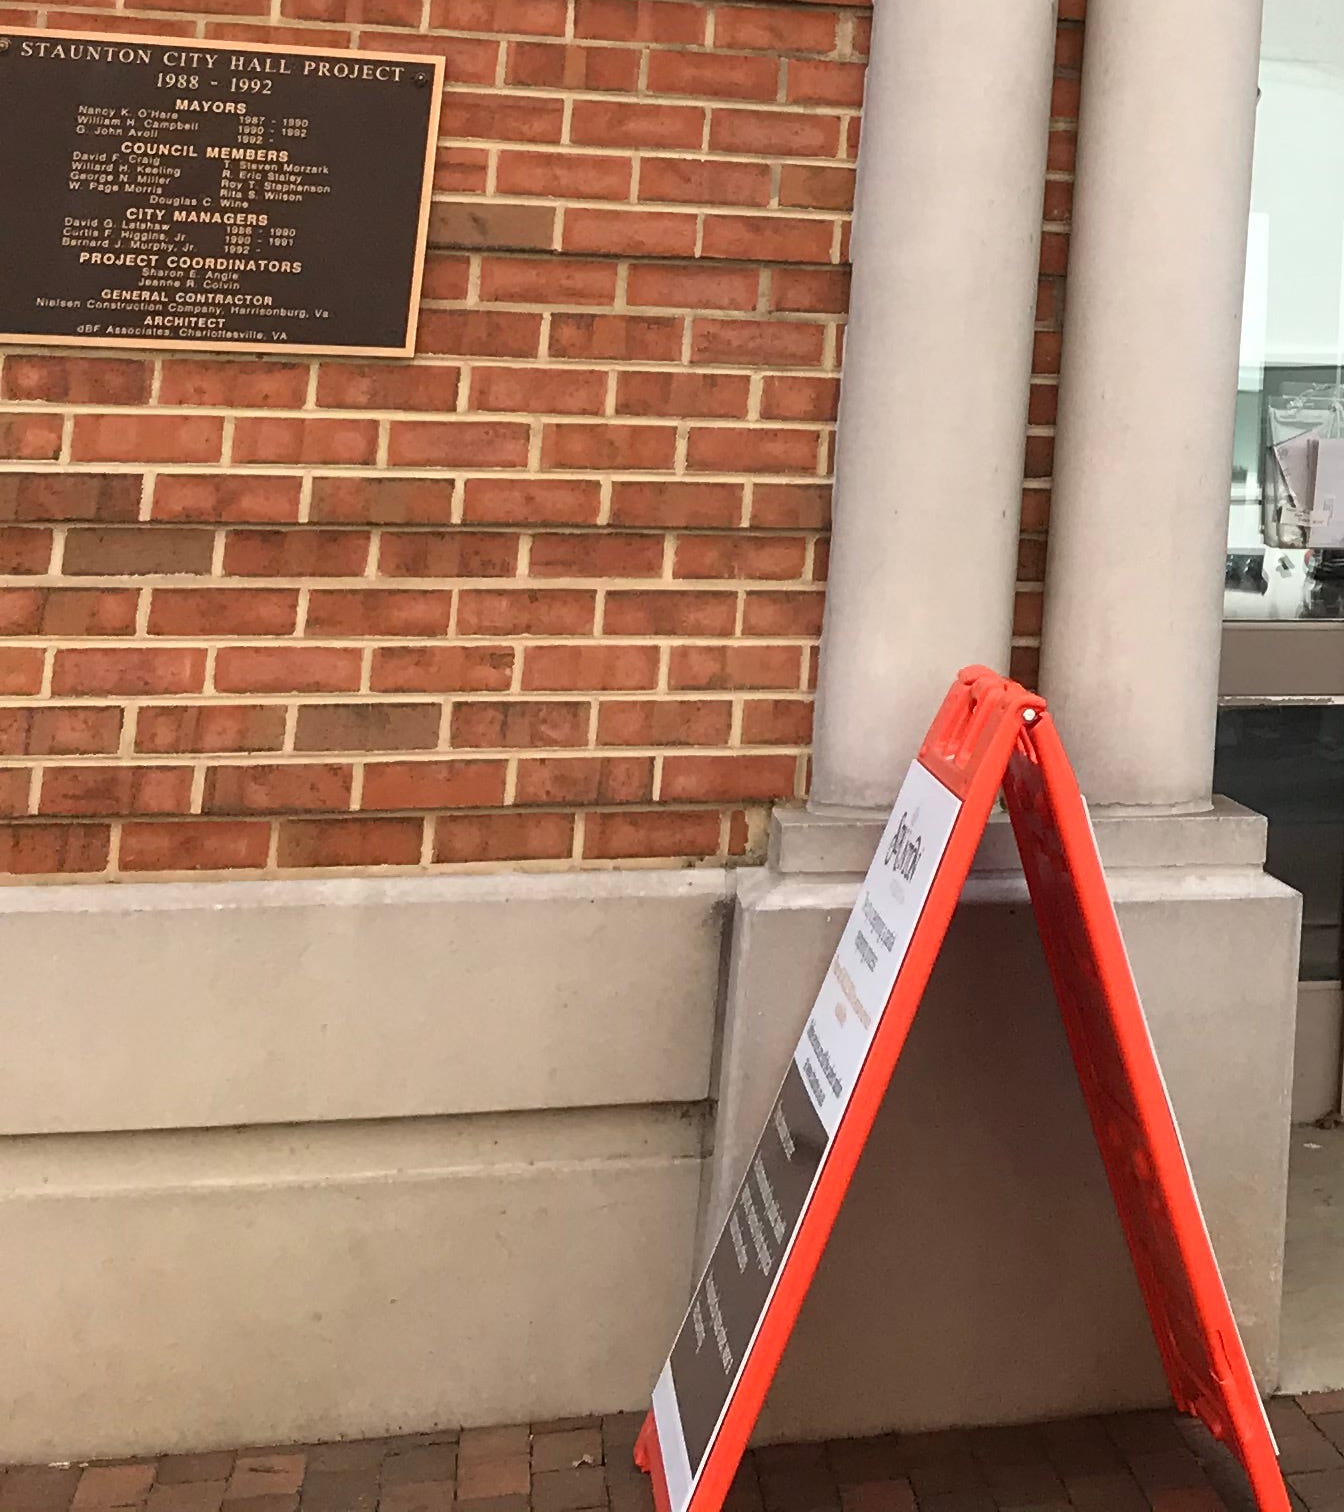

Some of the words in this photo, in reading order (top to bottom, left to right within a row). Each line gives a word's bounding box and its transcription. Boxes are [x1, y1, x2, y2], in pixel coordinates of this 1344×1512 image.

[21, 42, 152, 64] STAUNTON
[163, 51, 218, 68] CITY
[230, 56, 292, 74] HALL
[303, 60, 405, 82] PROJECT
[157, 72, 200, 90] 1988
[230, 78, 272, 95] 1992
[78, 106, 116, 116] Nancy
[176, 99, 246, 114] MAYORS
[77, 115, 121, 126] William
[144, 119, 198, 130] Campbell
[94, 127, 123, 135] John
[72, 151, 107, 161] David
[128, 154, 160, 166] Craig
[121, 142, 198, 157] COUNCIL
[206, 147, 288, 162] MEMBERS
[71, 161, 114, 172] Willard
[137, 166, 181, 177] Keeling
[239, 171, 262, 180] Eric
[70, 171, 114, 182] George
[137, 175, 171, 185] Miller
[89, 182, 119, 193] Page
[125, 184, 162, 194] Morris
[221, 179, 242, 189] Roy
[264, 182, 330, 193] Stephenson
[150, 195, 197, 206] Douglas
[220, 199, 249, 208] Wine
[220, 189, 242, 198] Rita
[264, 192, 302, 201] Wilson
[64, 217, 98, 227] David
[126, 208, 166, 221] CITY
[173, 211, 268, 226] MANAGERS
[62, 228, 98, 237] Curtis
[62, 237, 109, 248] Bernard
[79, 252, 159, 266] PROJECT
[167, 256, 302, 273] COORDINATORS
[142, 268, 184, 278] Sharon
[138, 278, 180, 287] Jeanne
[203, 280, 240, 289] Colvin
[36, 297, 81, 308] Nielsen
[87, 299, 162, 311] Construction
[101, 289, 168, 302] GENERAL
[176, 292, 273, 306] CONTRACTOR
[144, 316, 225, 328] ARCHITECT
